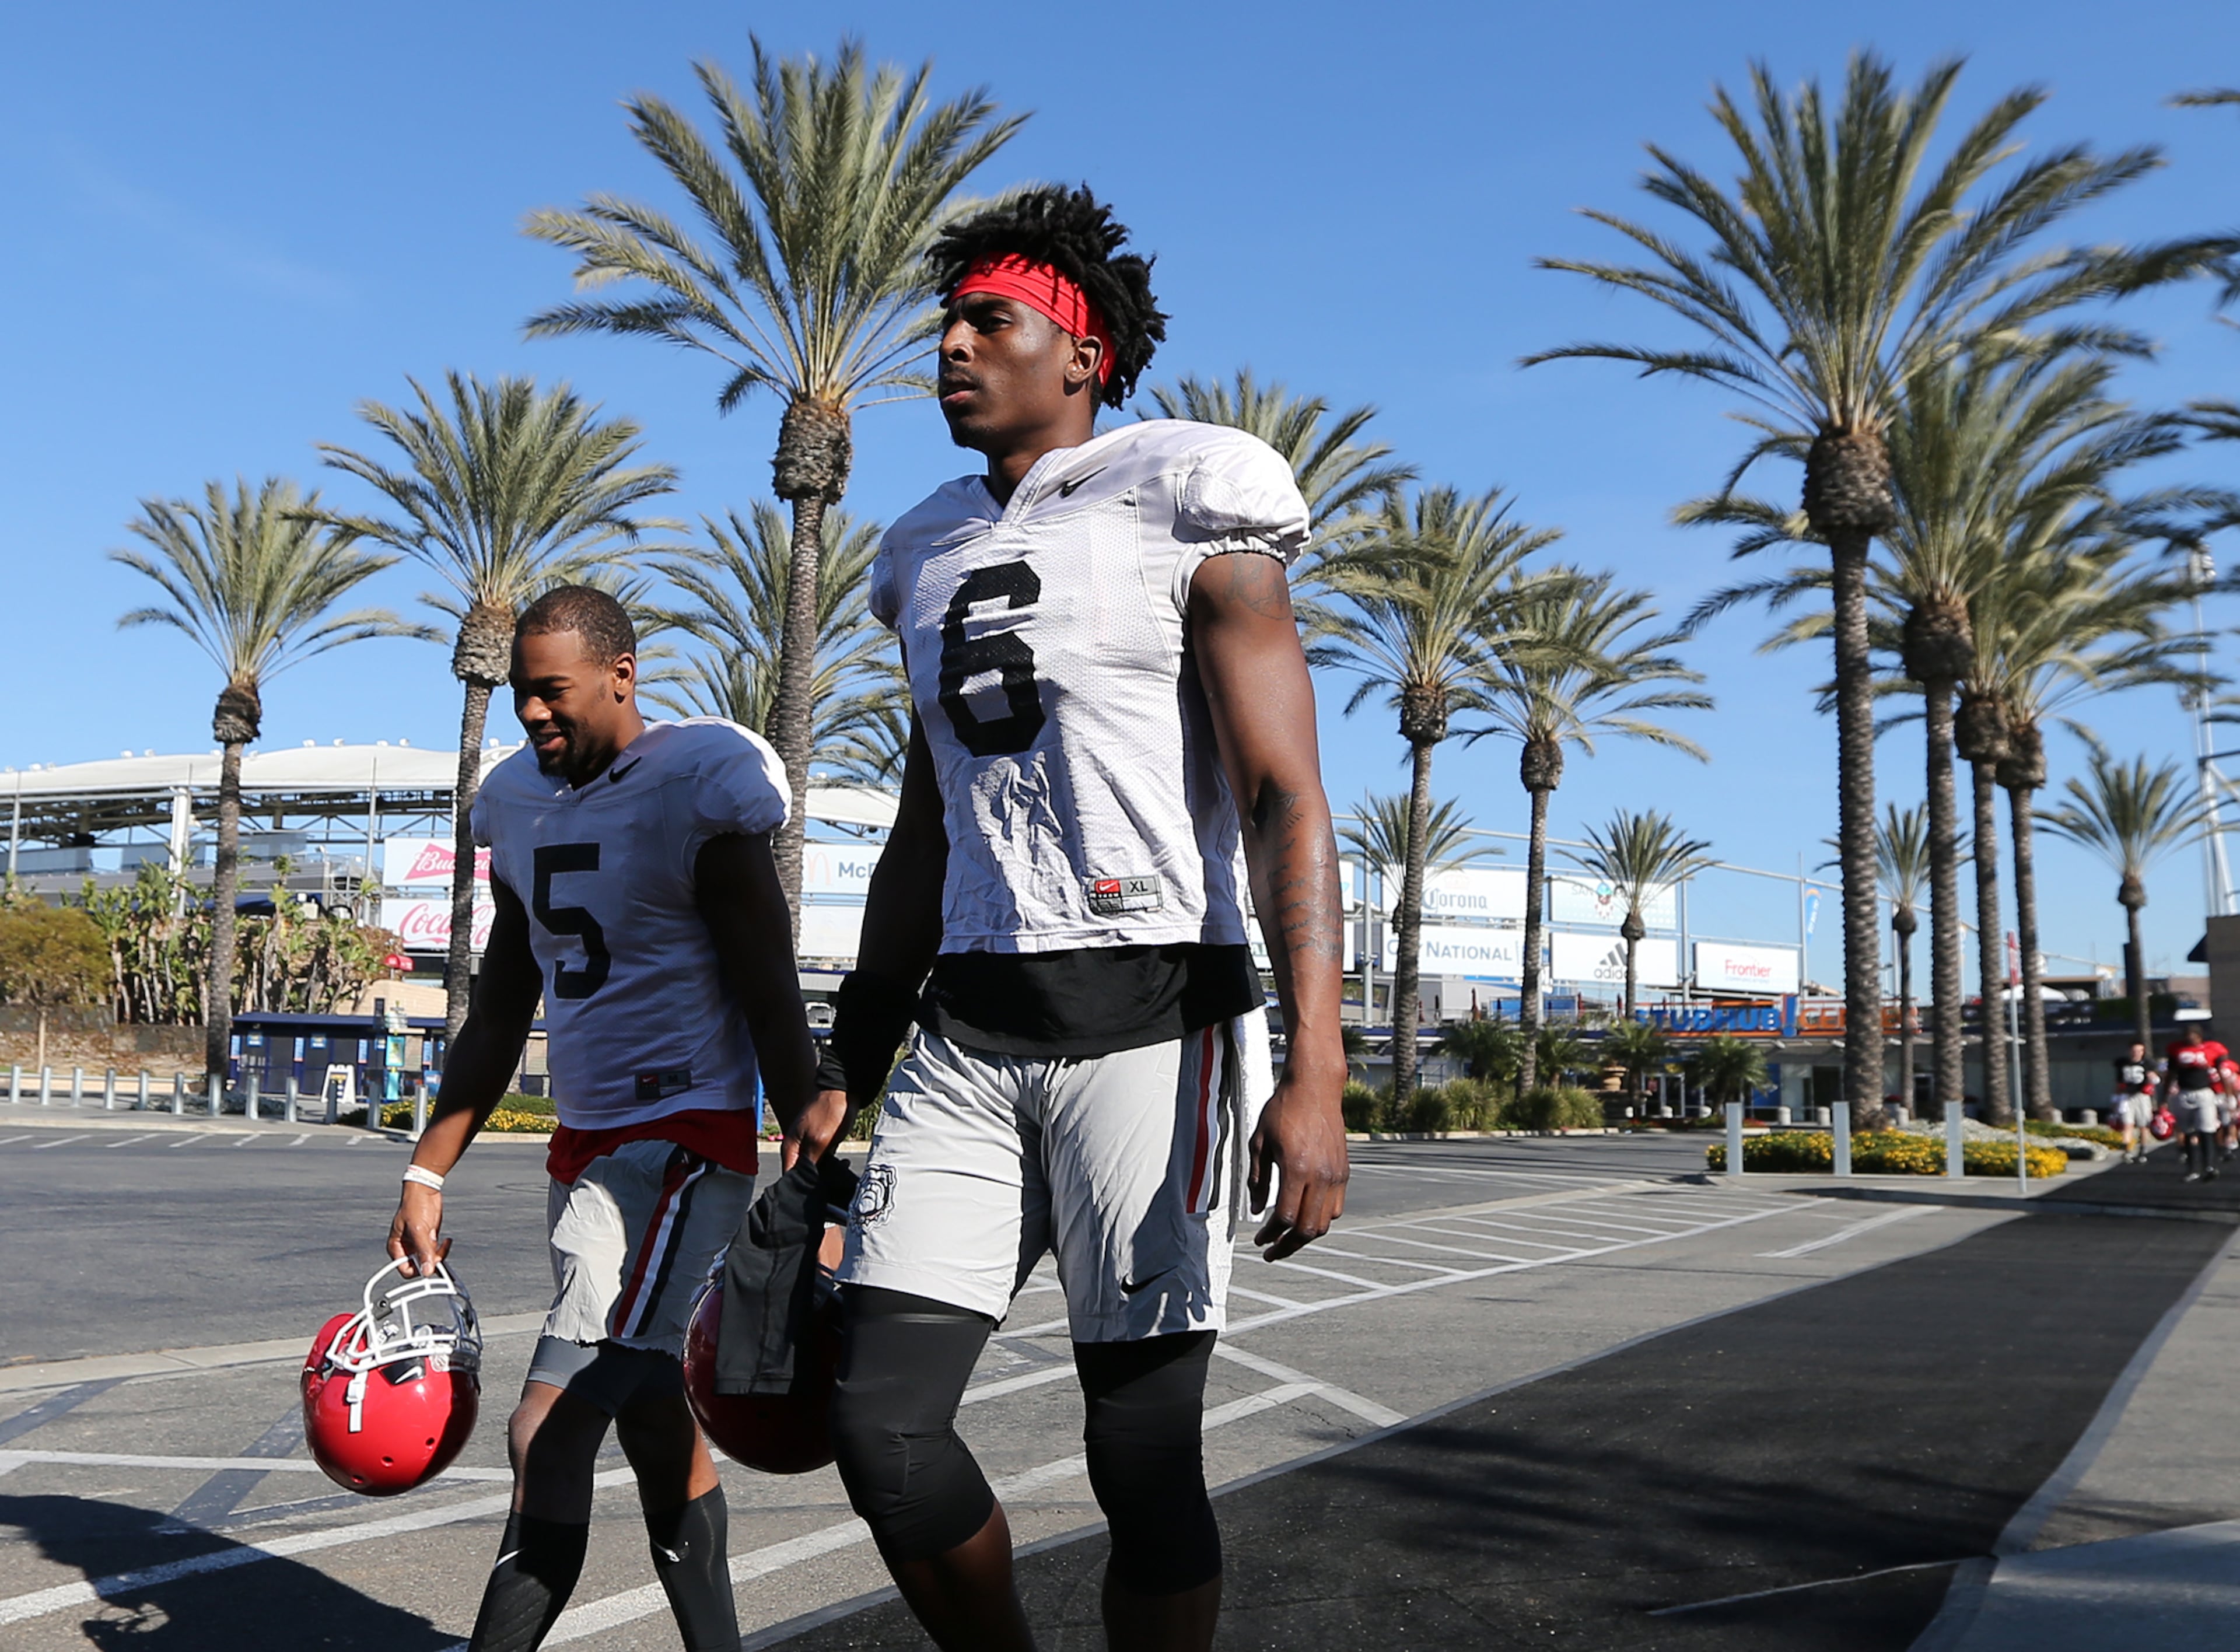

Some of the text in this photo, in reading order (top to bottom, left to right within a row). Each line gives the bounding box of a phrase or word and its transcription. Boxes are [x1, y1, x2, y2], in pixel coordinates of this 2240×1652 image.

[939, 560, 1046, 758] 6
[1130, 880, 1149, 893] XL
[1422, 887, 1489, 914] Corona
[532, 843, 611, 999] 5
[1426, 940, 1513, 961] NATIONAL
[1594, 968, 1639, 981] adid
[1724, 959, 1772, 978] Frontier
